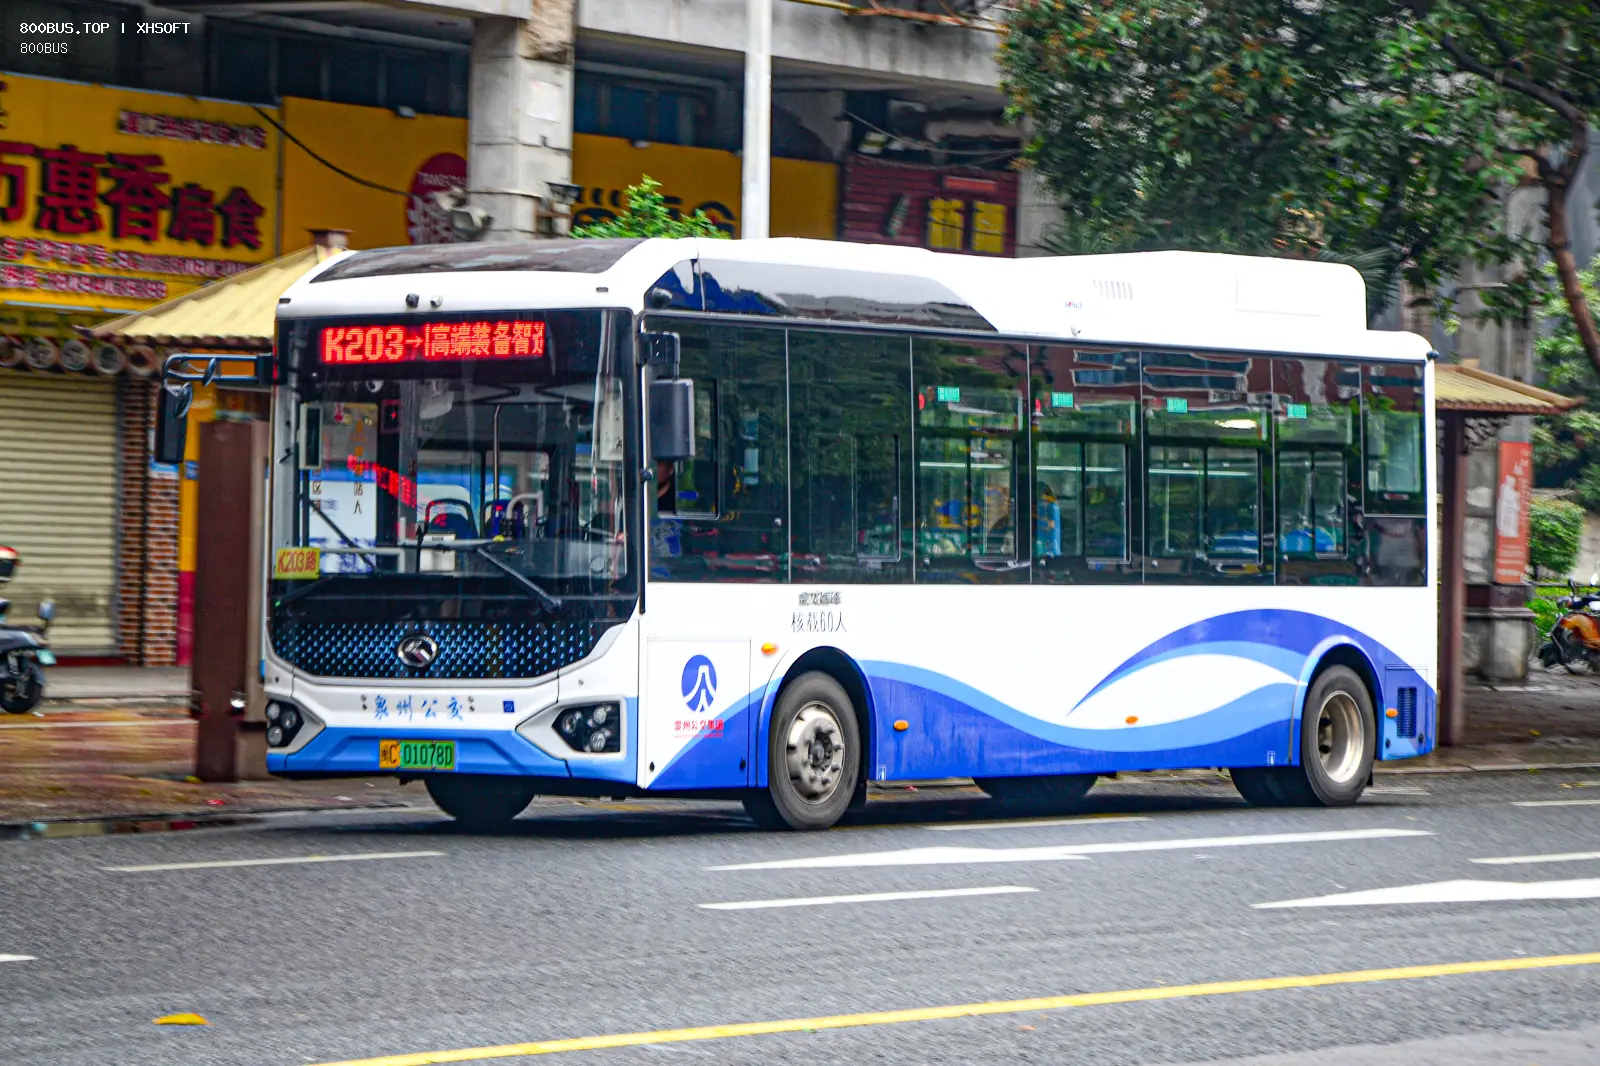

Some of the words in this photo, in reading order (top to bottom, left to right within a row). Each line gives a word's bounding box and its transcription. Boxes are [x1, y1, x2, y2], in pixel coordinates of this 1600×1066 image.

[323, 327, 405, 363] K203
[425, 321, 545, 357] 高端装备智
[791, 611, 848, 633] 核载60人
[373, 695, 464, 721] 泉州公交
